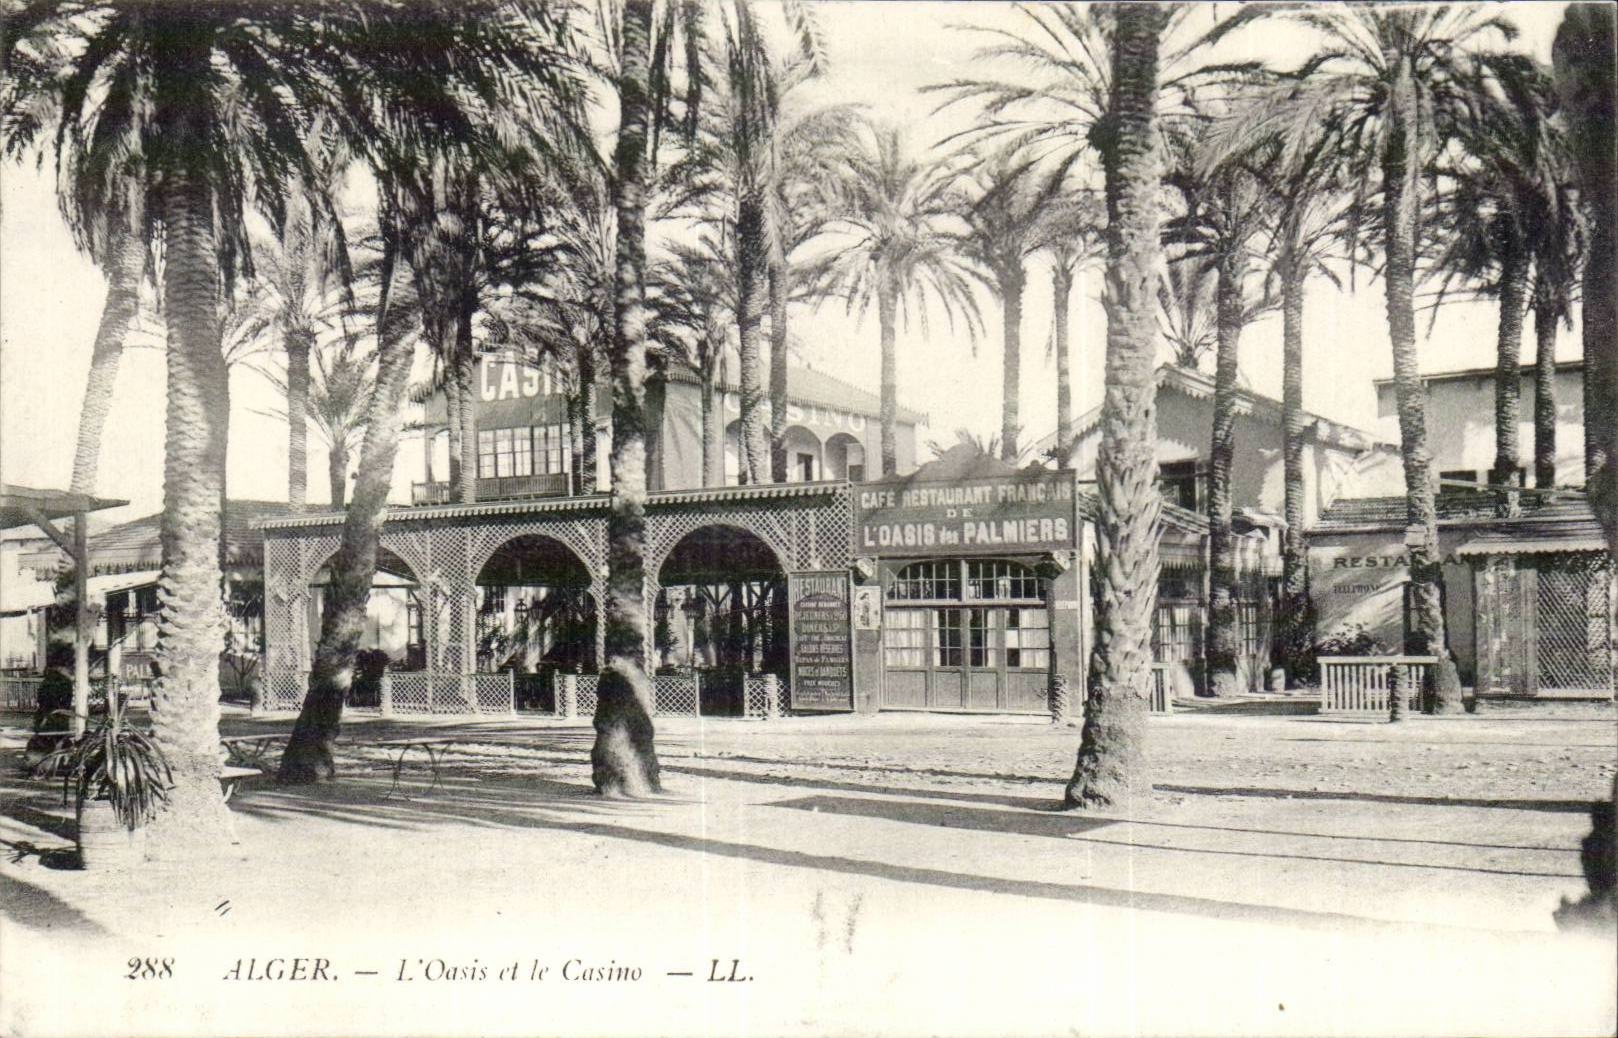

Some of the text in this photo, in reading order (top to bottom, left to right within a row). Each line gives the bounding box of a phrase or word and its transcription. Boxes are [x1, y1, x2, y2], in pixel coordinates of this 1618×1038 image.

[481, 351, 564, 401] CASI
[902, 486, 993, 508] RESTAURANT
[864, 517, 1068, 546] L'OASIS des PALMIERS
[126, 664, 151, 679] PAL
